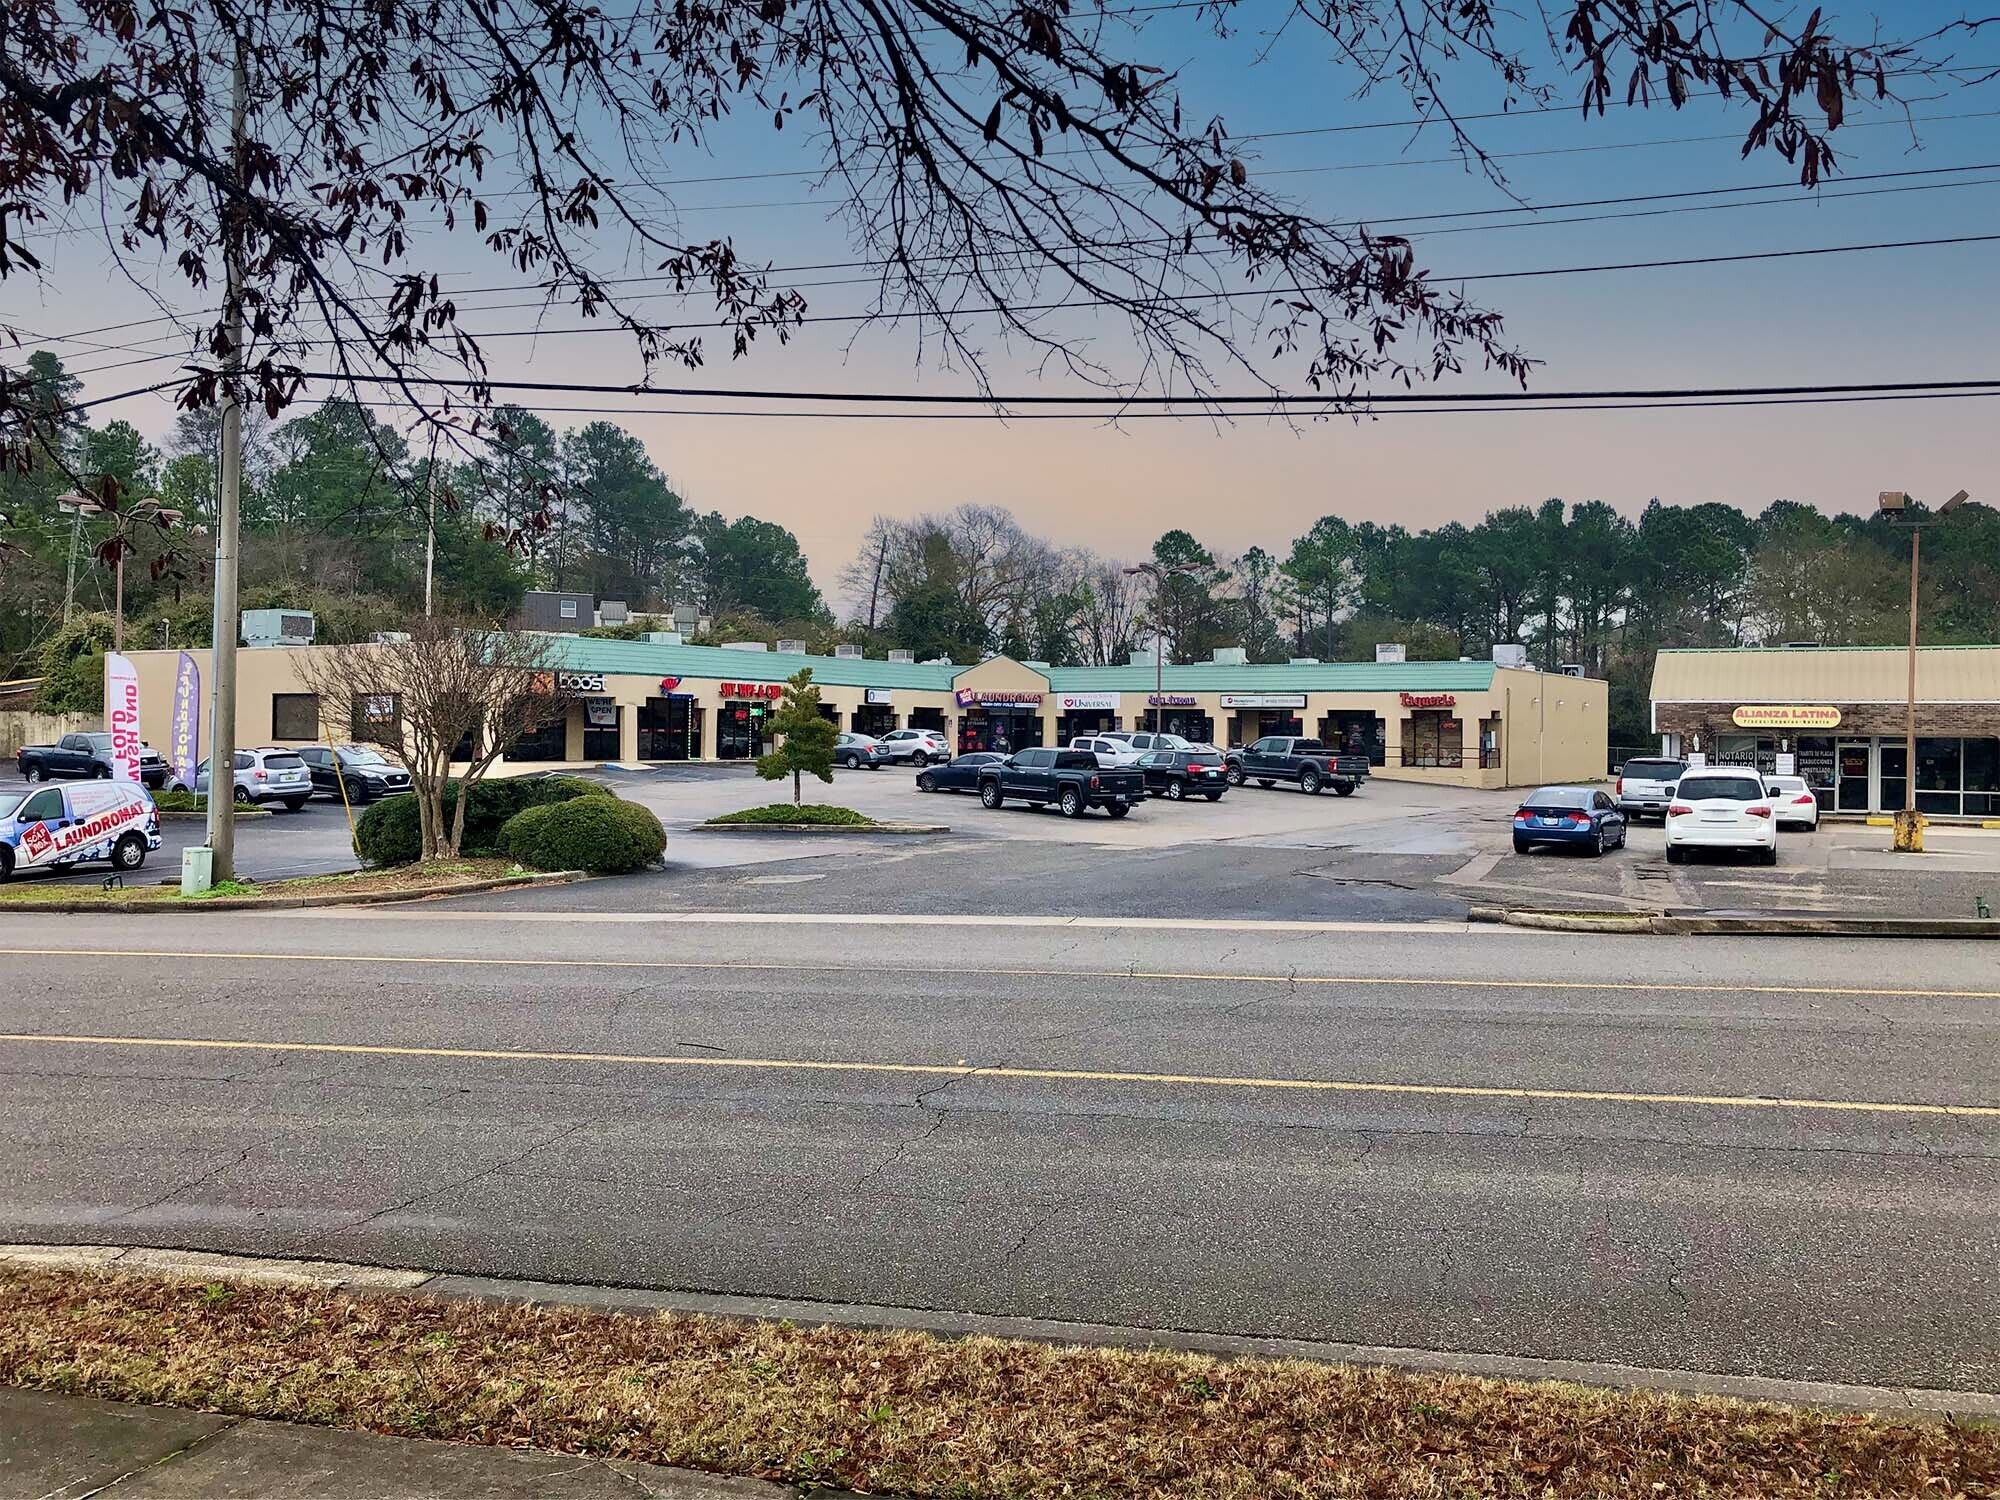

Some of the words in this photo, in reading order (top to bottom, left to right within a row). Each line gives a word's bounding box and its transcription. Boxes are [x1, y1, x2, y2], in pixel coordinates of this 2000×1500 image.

[559, 672, 608, 691] boost
[1400, 692, 1456, 708] Taqueria
[590, 706, 613, 714] OPEN
[1735, 709, 1789, 718] ALIANZA
[1792, 709, 1839, 719] LATINA
[177, 662, 193, 778] LAUNDROMAT
[1719, 751, 1754, 760] NOTARIO
[54, 800, 145, 851] LAUNDROMAT
[26, 829, 46, 845] SOAP
